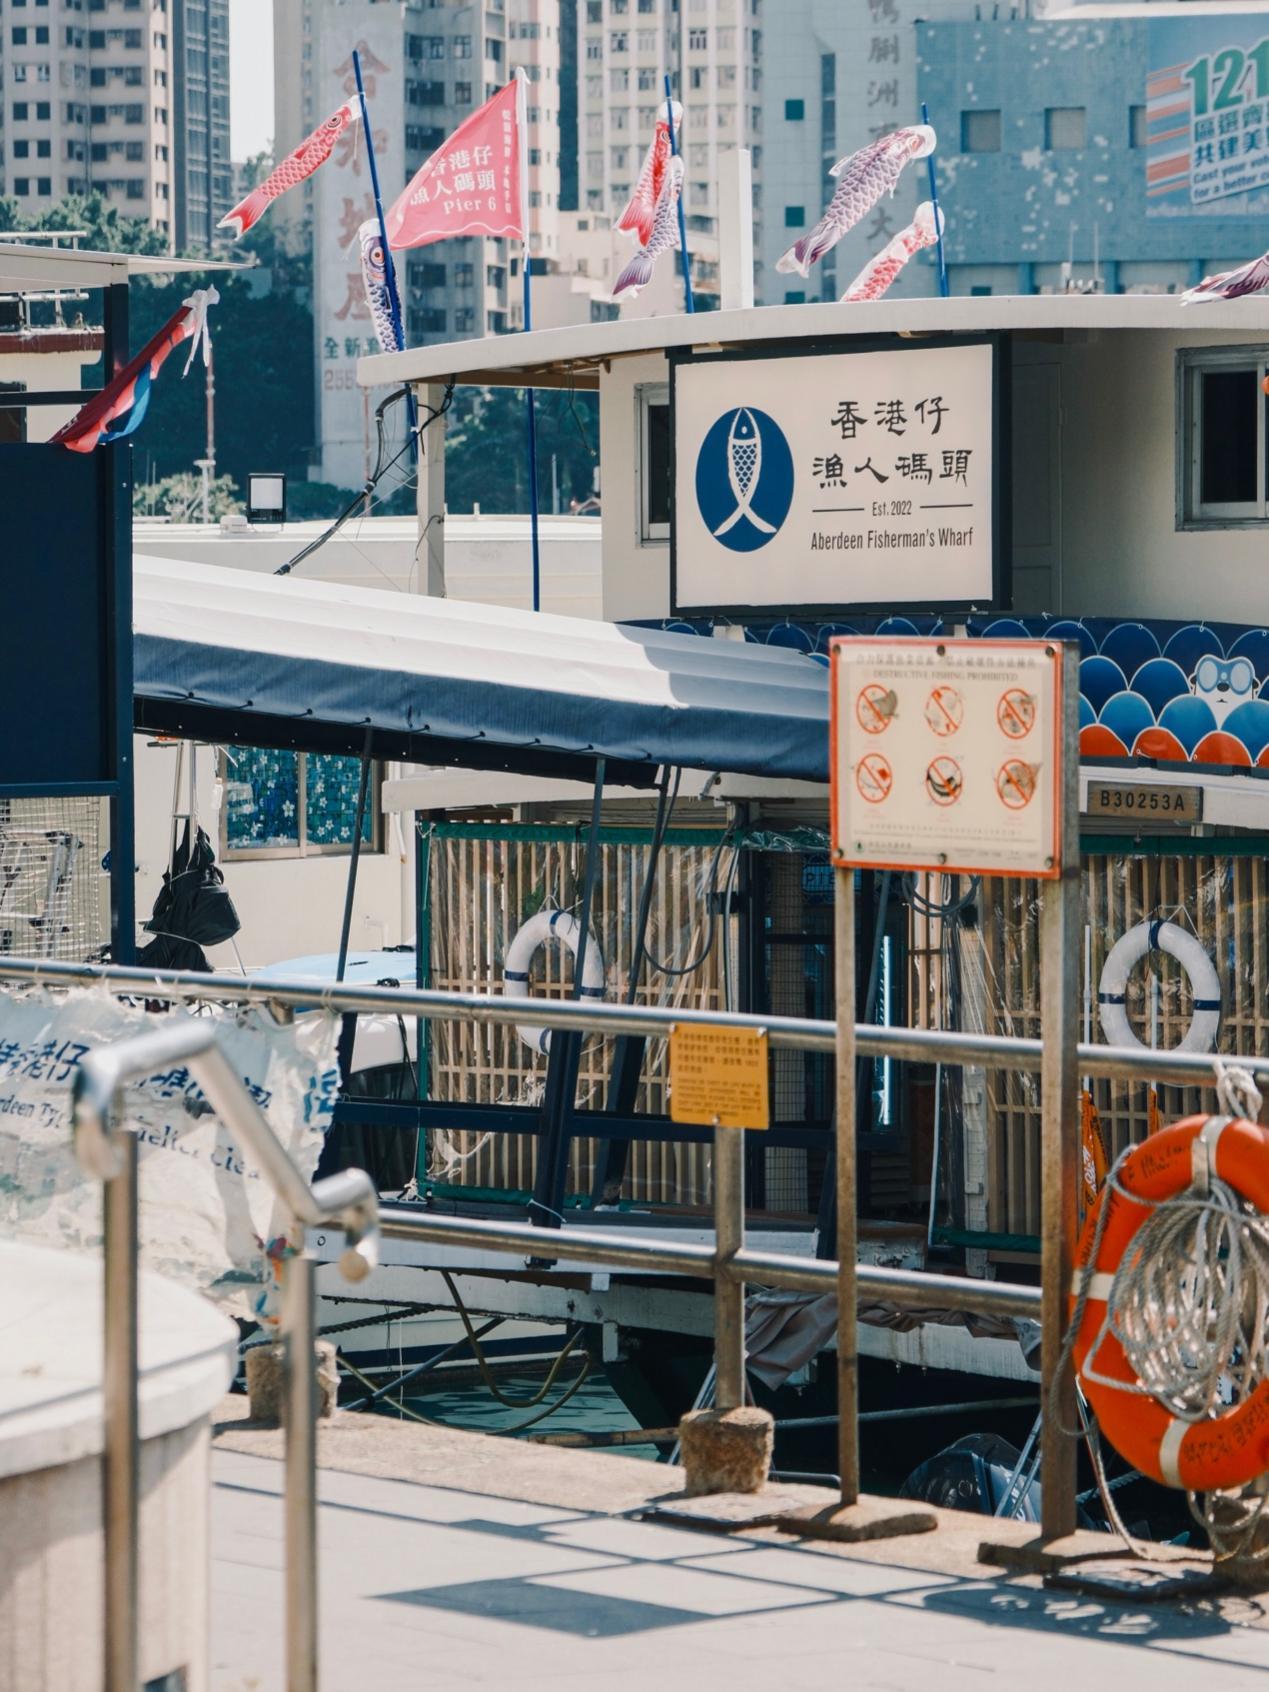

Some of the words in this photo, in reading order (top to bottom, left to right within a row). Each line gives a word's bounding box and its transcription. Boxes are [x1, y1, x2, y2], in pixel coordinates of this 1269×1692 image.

[1194, 101, 1269, 143] 區選齊
[1194, 126, 1269, 168] 共建美
[1193, 186, 1210, 200] for
[1213, 185, 1220, 194] a
[1223, 173, 1257, 192] better
[443, 198, 482, 215] Pier
[488, 196, 497, 211] 6
[831, 396, 950, 440] 香港仔
[811, 449, 973, 489] 漁人碼頭
[811, 531, 864, 552] Aberdeen
[867, 529, 935, 550] Fisherman's
[938, 527, 973, 547] Wharf
[1101, 790, 1185, 812] B30253A
